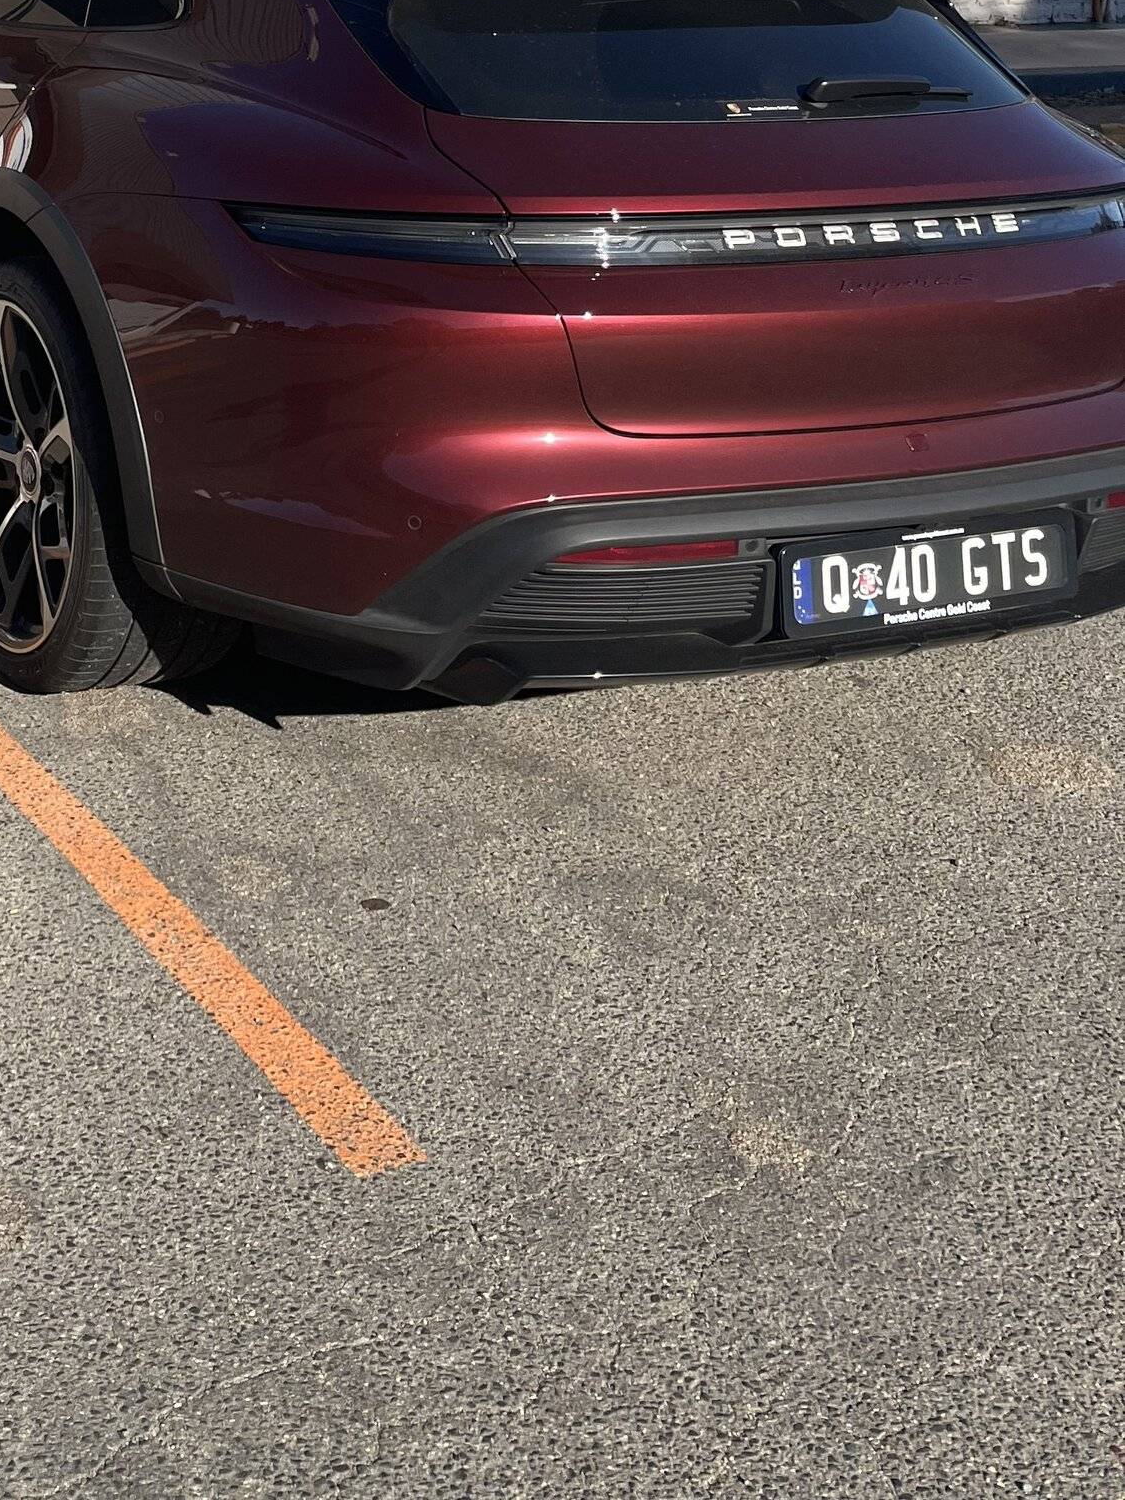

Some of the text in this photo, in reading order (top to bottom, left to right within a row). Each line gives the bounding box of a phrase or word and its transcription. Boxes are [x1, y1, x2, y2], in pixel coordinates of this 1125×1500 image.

[722, 213, 1020, 249] PORSCHE
[961, 529, 1048, 596] GTS
[884, 599, 991, 625] Porsche Centre Gold Coast
